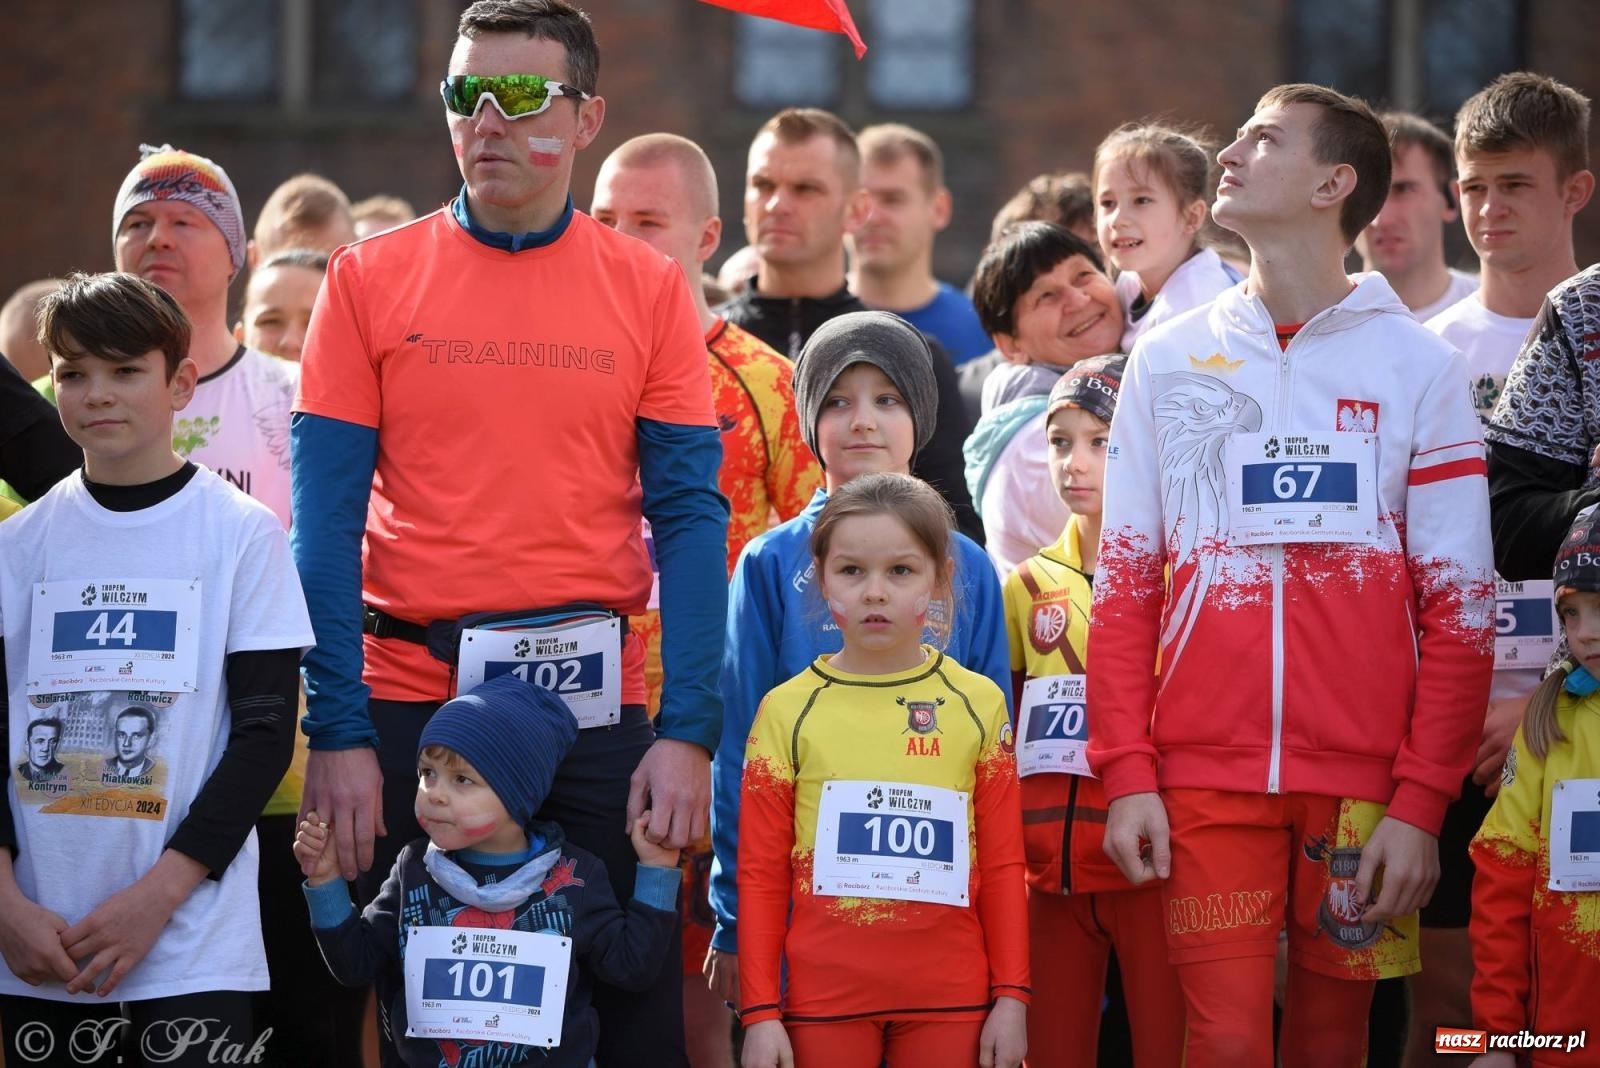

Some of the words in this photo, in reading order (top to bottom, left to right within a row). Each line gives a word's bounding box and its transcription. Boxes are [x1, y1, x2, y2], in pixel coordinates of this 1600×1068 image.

[422, 340, 616, 374] TRAINING
[1285, 445, 1330, 456] WILCZYM
[1273, 464, 1322, 499] 67
[1496, 583, 1524, 593] CZYM
[101, 592, 148, 603] WILCZYM
[86, 612, 137, 646] 44
[535, 641, 578, 655] WILCZYM
[511, 659, 582, 691] 102
[1045, 705, 1085, 737] 70
[905, 737, 941, 756] ALA
[101, 773, 153, 786] Miatkowski
[28, 781, 67, 793] Kontrym
[889, 788, 913, 797] TROPEM
[95, 800, 134, 812] EDYCJA
[136, 801, 160, 814] 2024
[889, 797, 932, 811] WILCZYM
[864, 816, 935, 856] 100
[473, 934, 496, 942] TROPEM
[1340, 927, 1364, 941] OCR
[472, 942, 517, 956] WILCZYM
[448, 962, 515, 1000] 101
